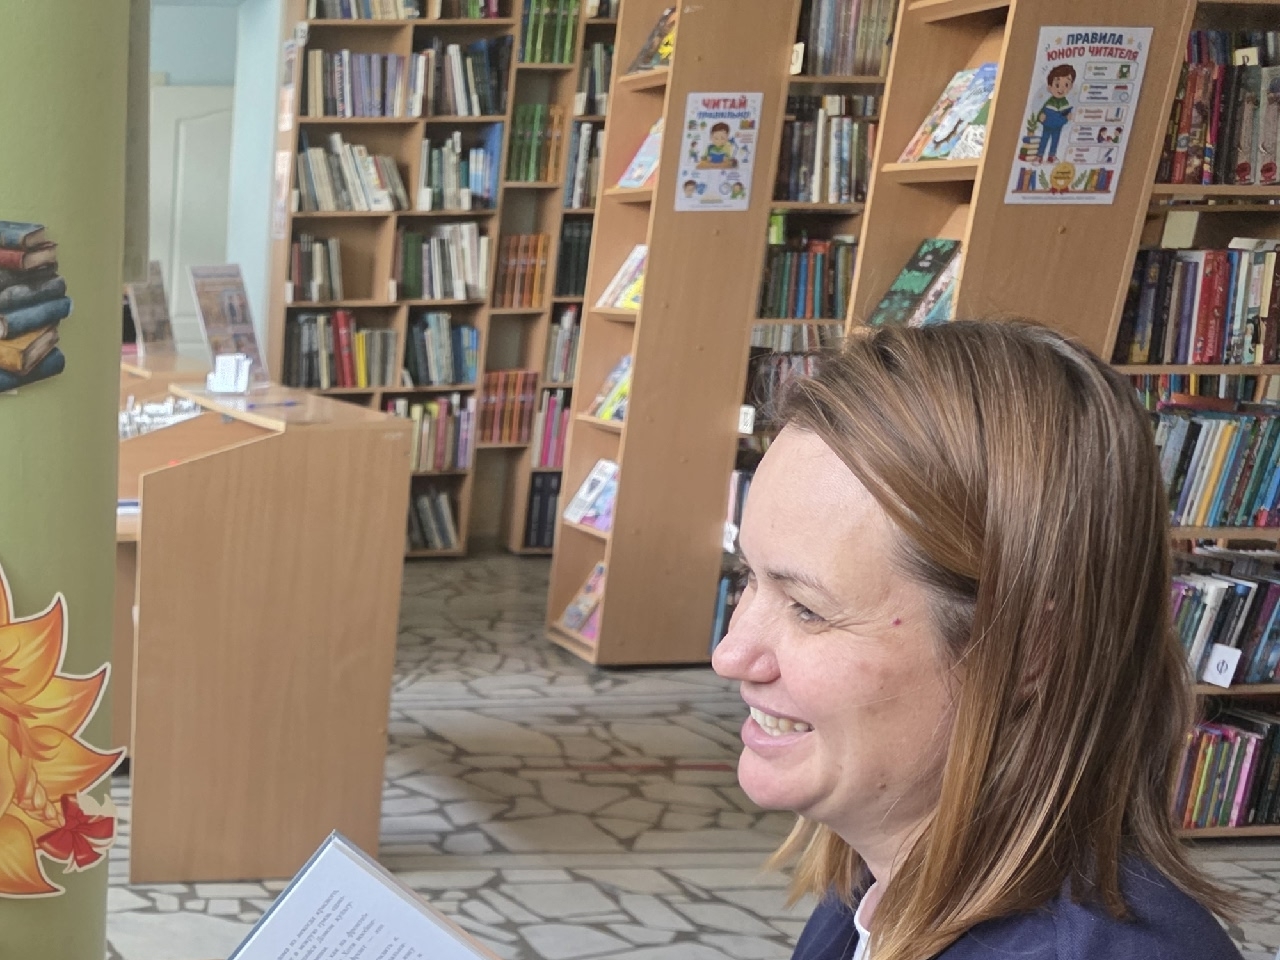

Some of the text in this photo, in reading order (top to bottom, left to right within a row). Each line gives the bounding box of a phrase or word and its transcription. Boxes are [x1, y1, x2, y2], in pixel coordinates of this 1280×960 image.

[1066, 32, 1124, 46] ПРАВИЛА
[1047, 46, 1140, 62] ЮНОГО ЧИТАТЕЛЯ
[702, 95, 748, 110] ЧИТАЙ
